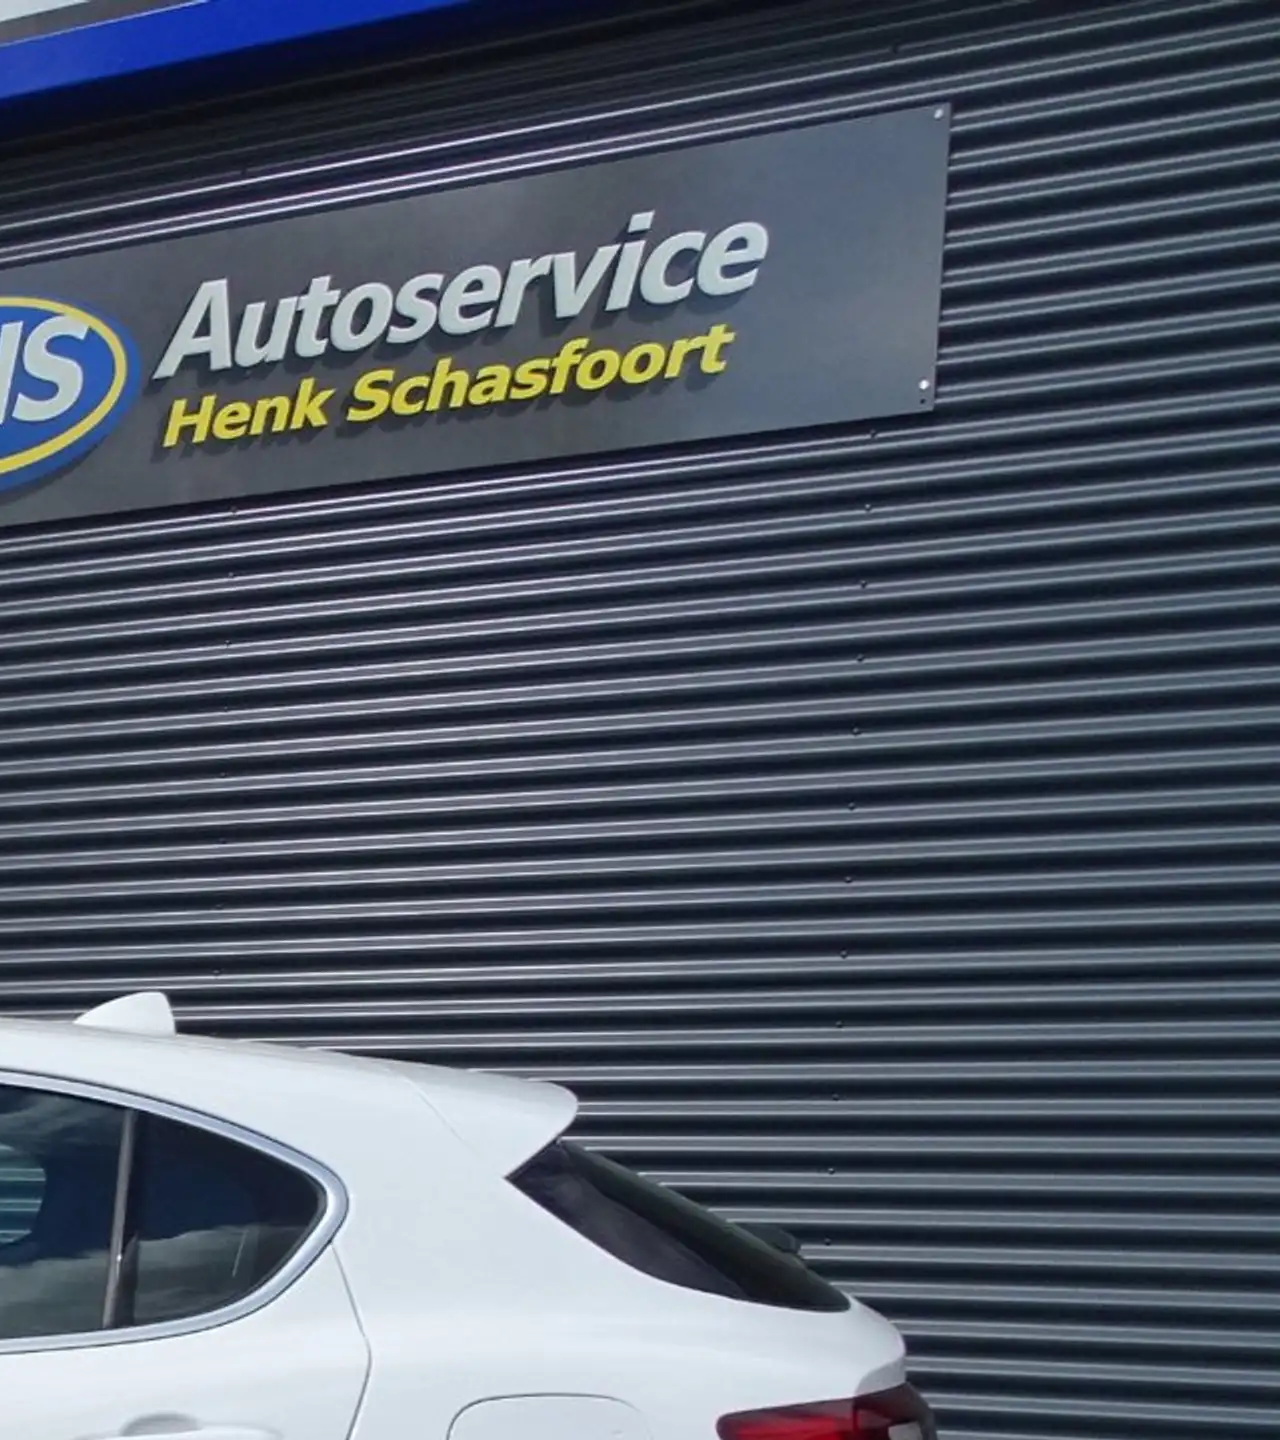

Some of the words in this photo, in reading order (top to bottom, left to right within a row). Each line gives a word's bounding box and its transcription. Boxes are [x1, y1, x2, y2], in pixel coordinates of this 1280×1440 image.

[153, 210, 770, 379] Autoservice
[164, 380, 333, 444] Henk
[346, 322, 735, 422] Schasfoort
